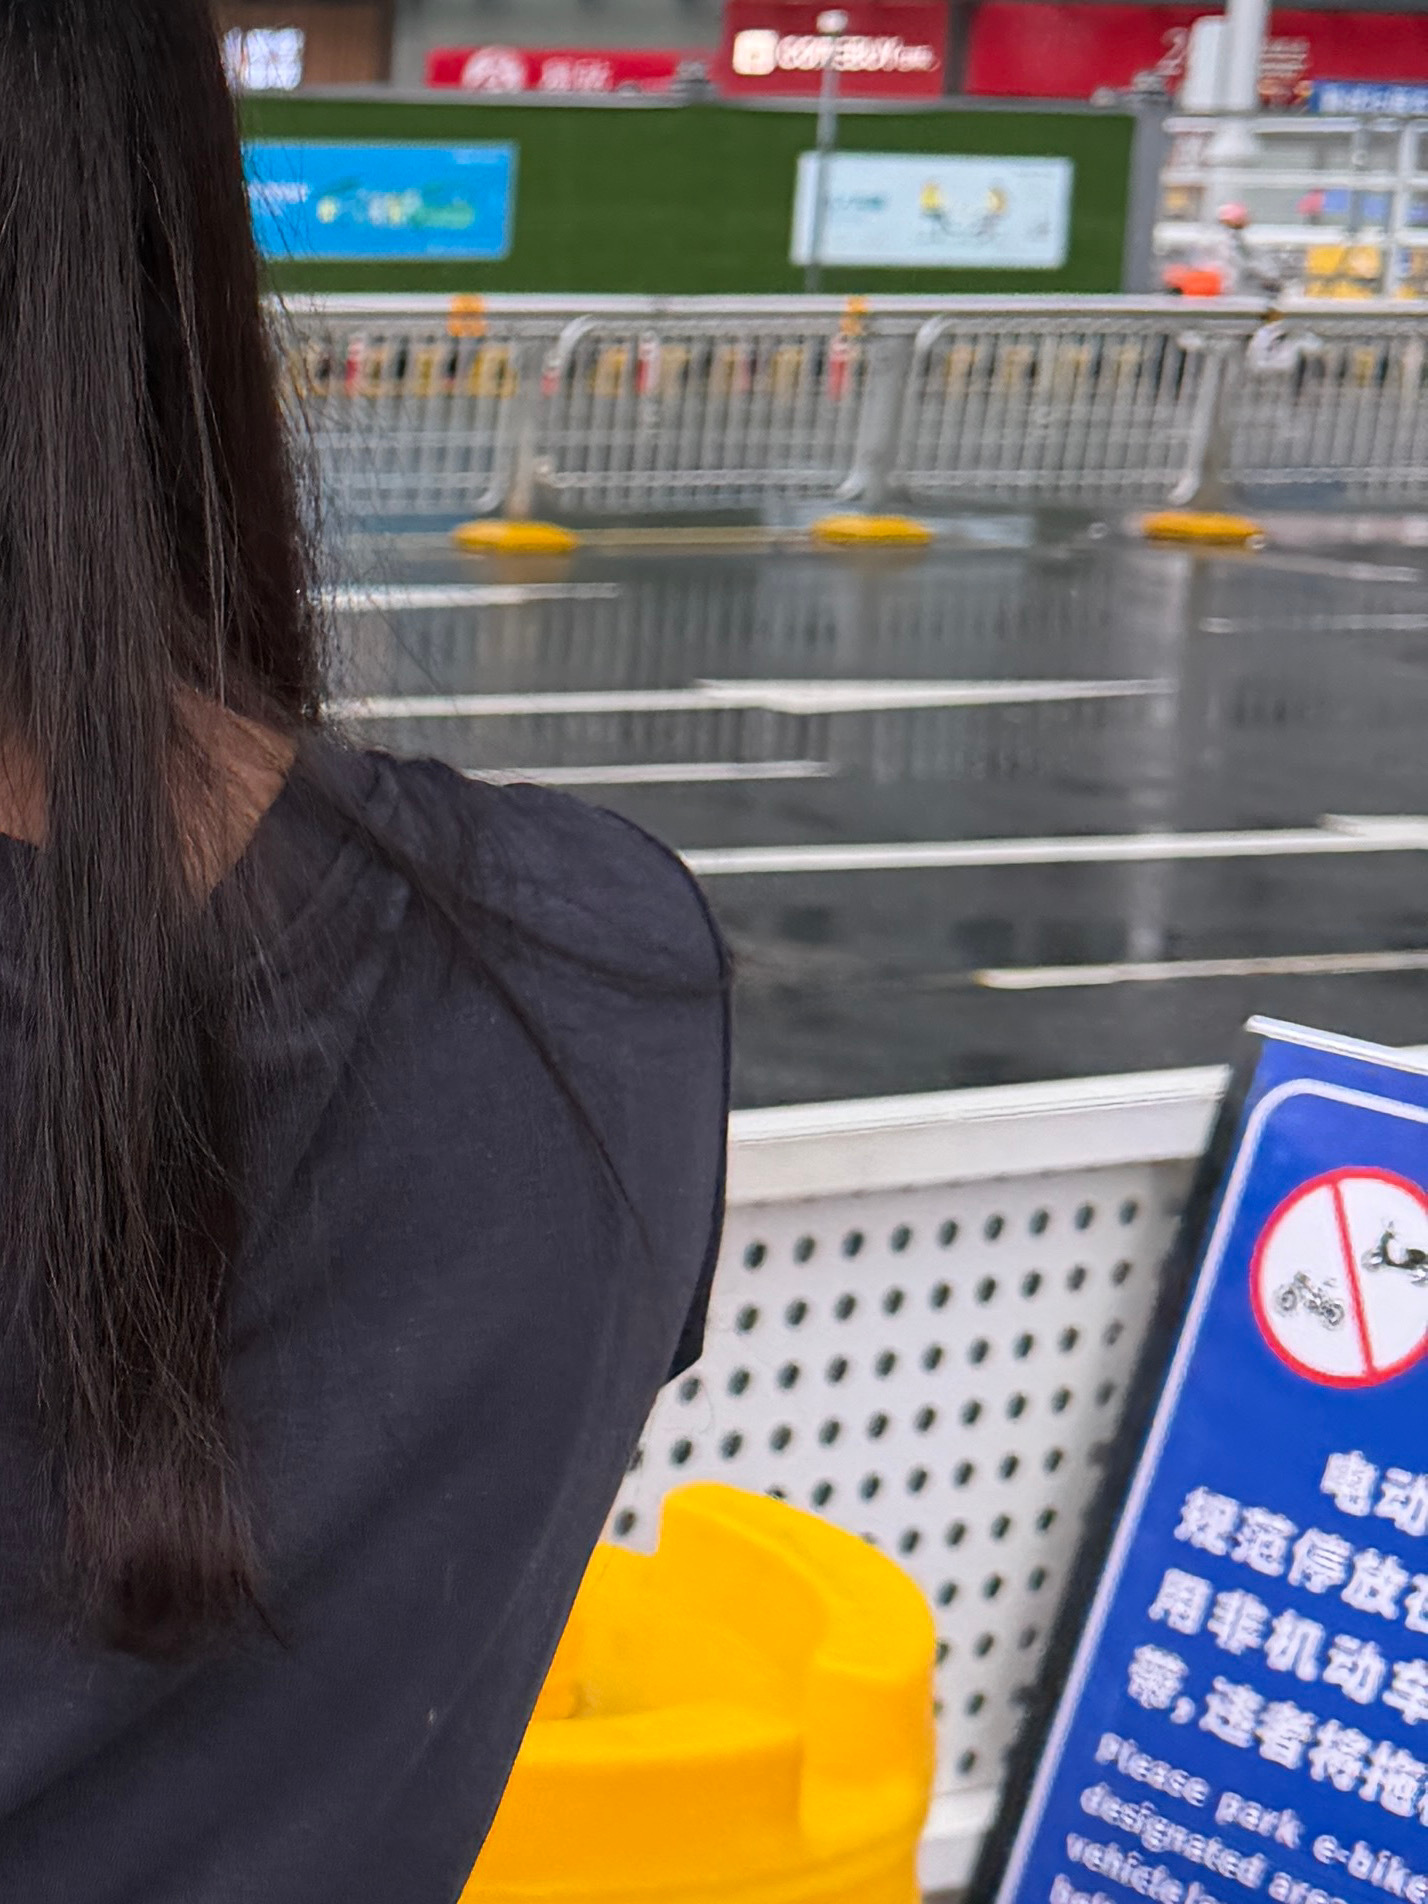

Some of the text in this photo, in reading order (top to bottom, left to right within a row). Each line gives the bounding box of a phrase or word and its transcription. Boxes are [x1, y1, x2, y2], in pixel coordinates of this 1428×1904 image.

[1081, 1782, 1268, 1889] designated
[1095, 1732, 1210, 1807] Please
[1215, 1792, 1306, 1849] park
